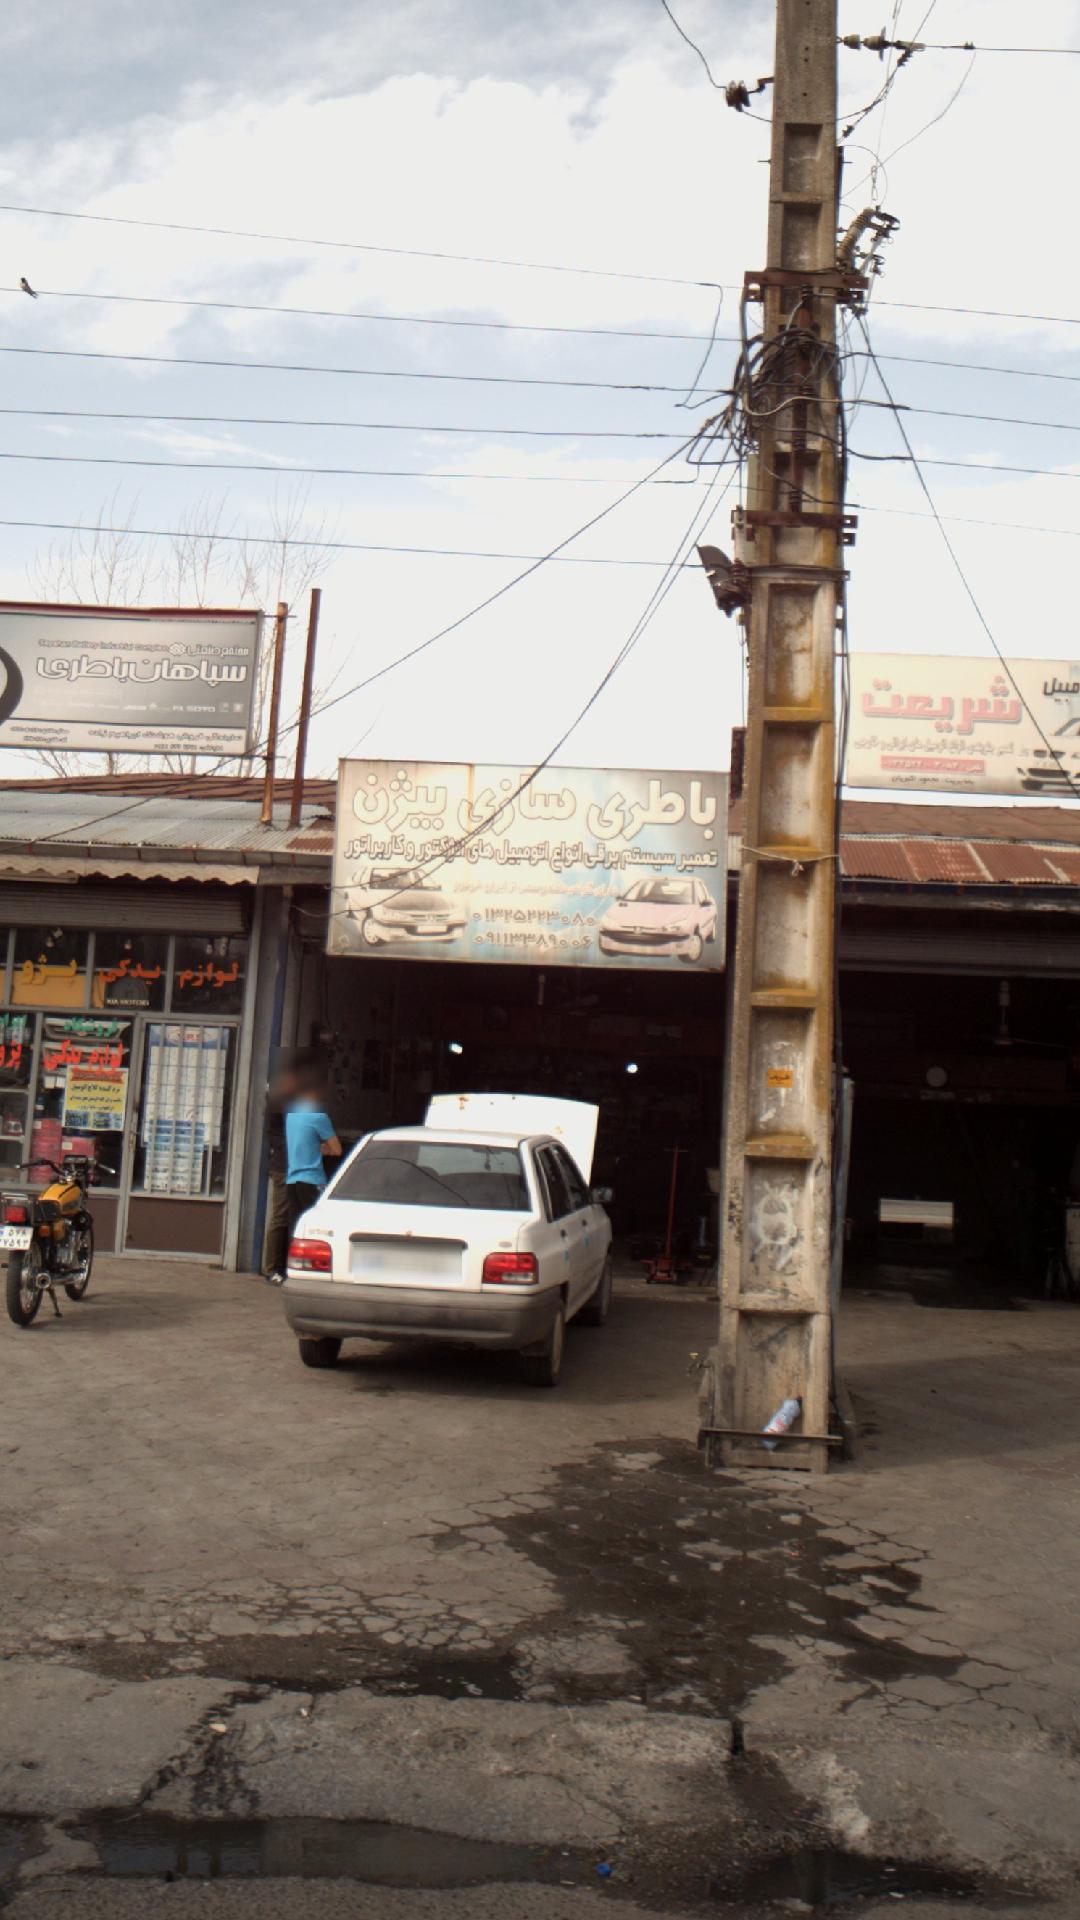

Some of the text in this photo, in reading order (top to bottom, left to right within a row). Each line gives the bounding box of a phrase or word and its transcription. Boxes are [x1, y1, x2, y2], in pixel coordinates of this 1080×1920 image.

[36, 654, 248, 687] سپاهان باطری
[861, 675, 1023, 736] شریعت
[352, 769, 717, 842] باطری سازی بیژن
[465, 838, 495, 865] های
[495, 839, 550, 867] اتومبیل
[549, 840, 584, 874] انواع
[583, 842, 620, 870] برقی
[620, 846, 677, 871] سیستم
[676, 849, 719, 873] تعمیر
[98, 957, 162, 986] یدکی
[178, 959, 240, 990] لوازم
